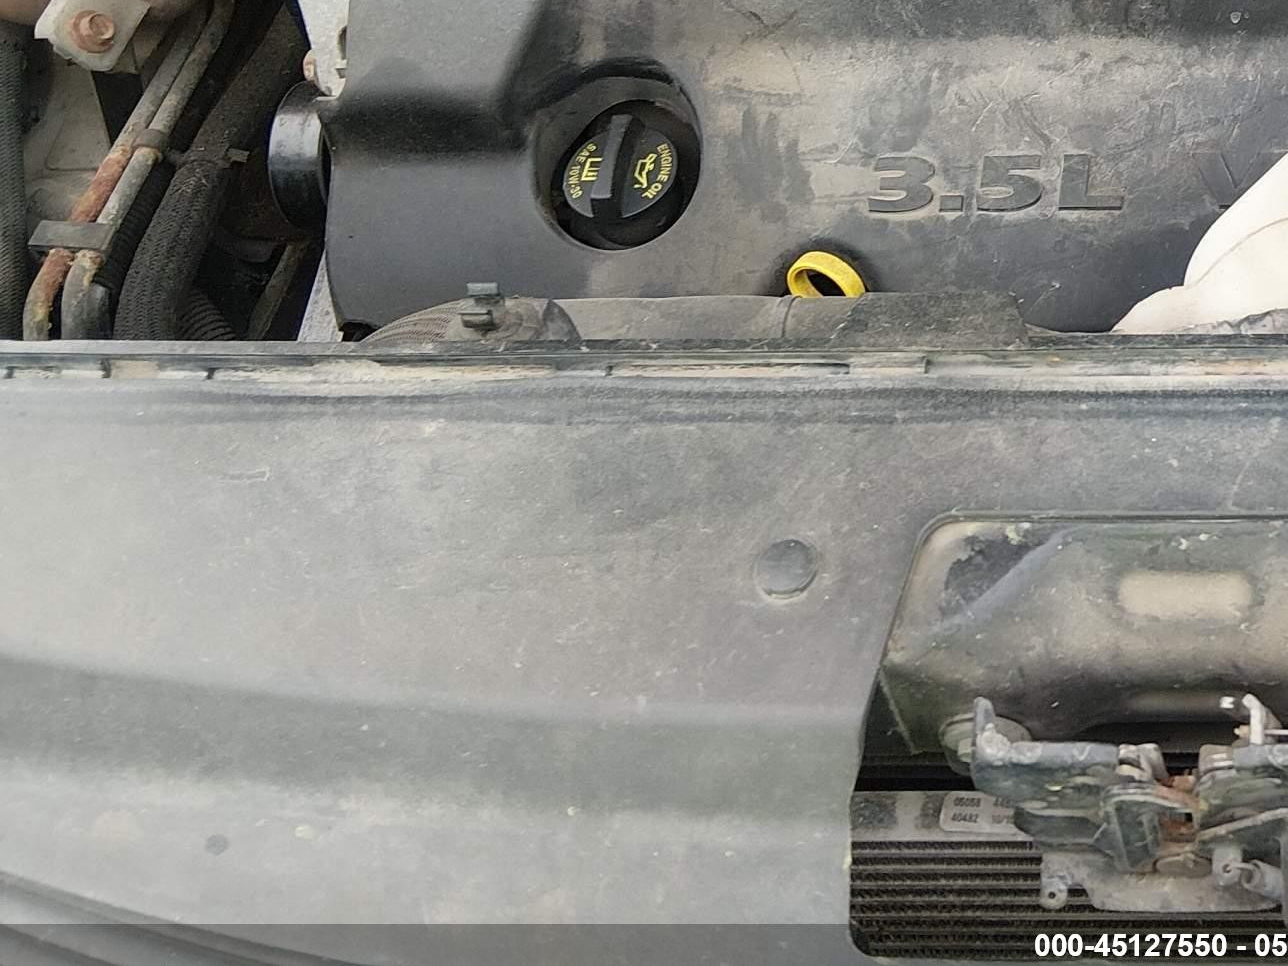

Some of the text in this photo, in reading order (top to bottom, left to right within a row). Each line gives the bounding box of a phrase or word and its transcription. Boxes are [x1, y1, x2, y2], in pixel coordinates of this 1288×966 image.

[575, 143, 598, 164] SAE
[641, 142, 673, 199] ENGINE OIL
[868, 152, 1125, 212] 3.5L
